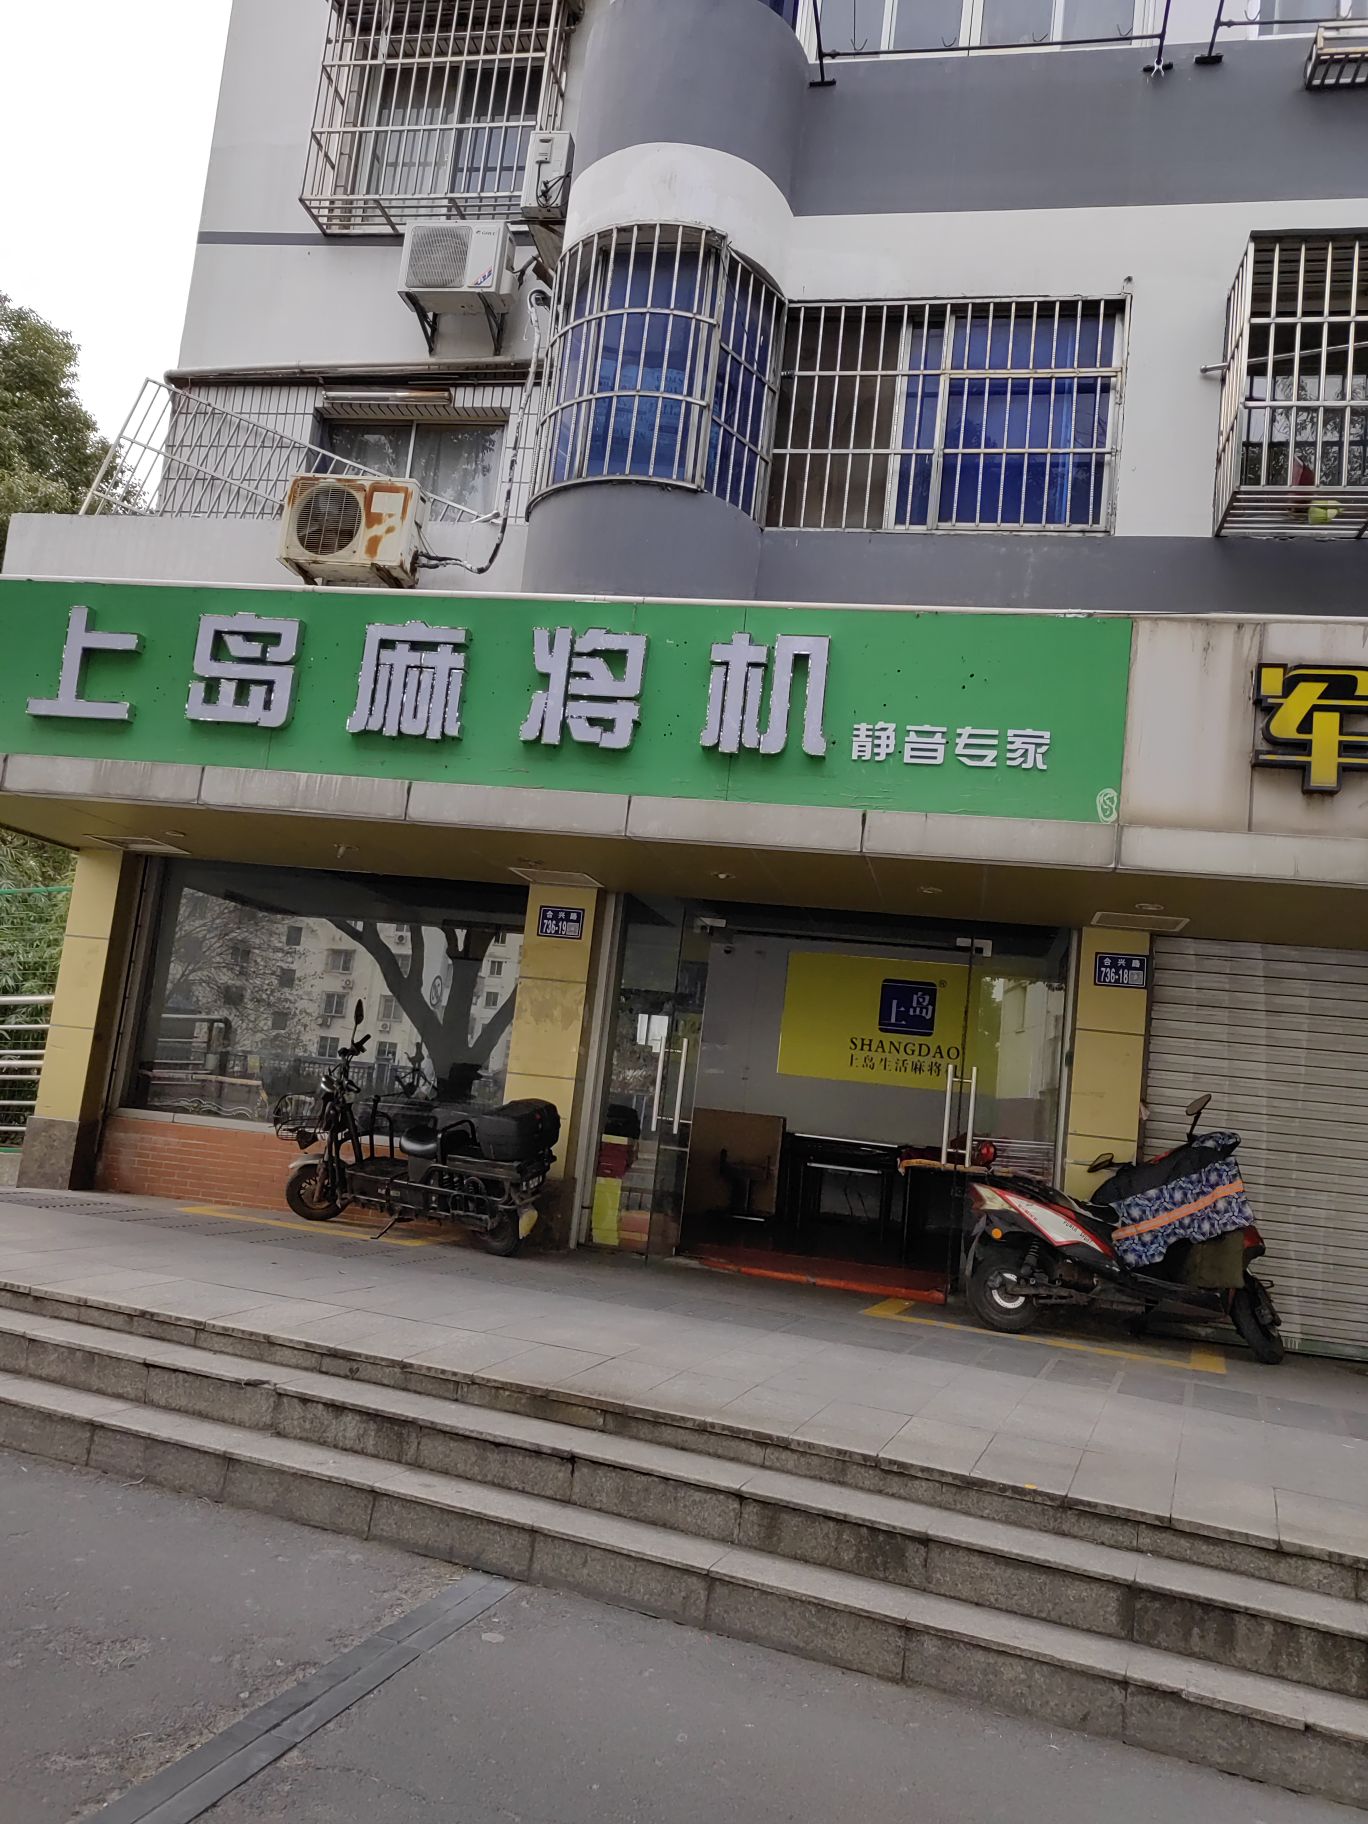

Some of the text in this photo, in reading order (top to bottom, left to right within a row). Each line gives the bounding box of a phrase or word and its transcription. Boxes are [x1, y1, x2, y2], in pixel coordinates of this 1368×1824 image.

[26, 604, 832, 759] 上岛麻将机
[1252, 663, 1368, 794] 军
[851, 722, 1052, 771] 静音专家
[543, 920, 567, 935] 736-19
[1100, 967, 1129, 983] 736-18
[881, 991, 934, 1025] 上岛
[849, 1036, 961, 1061] SHANGDAO
